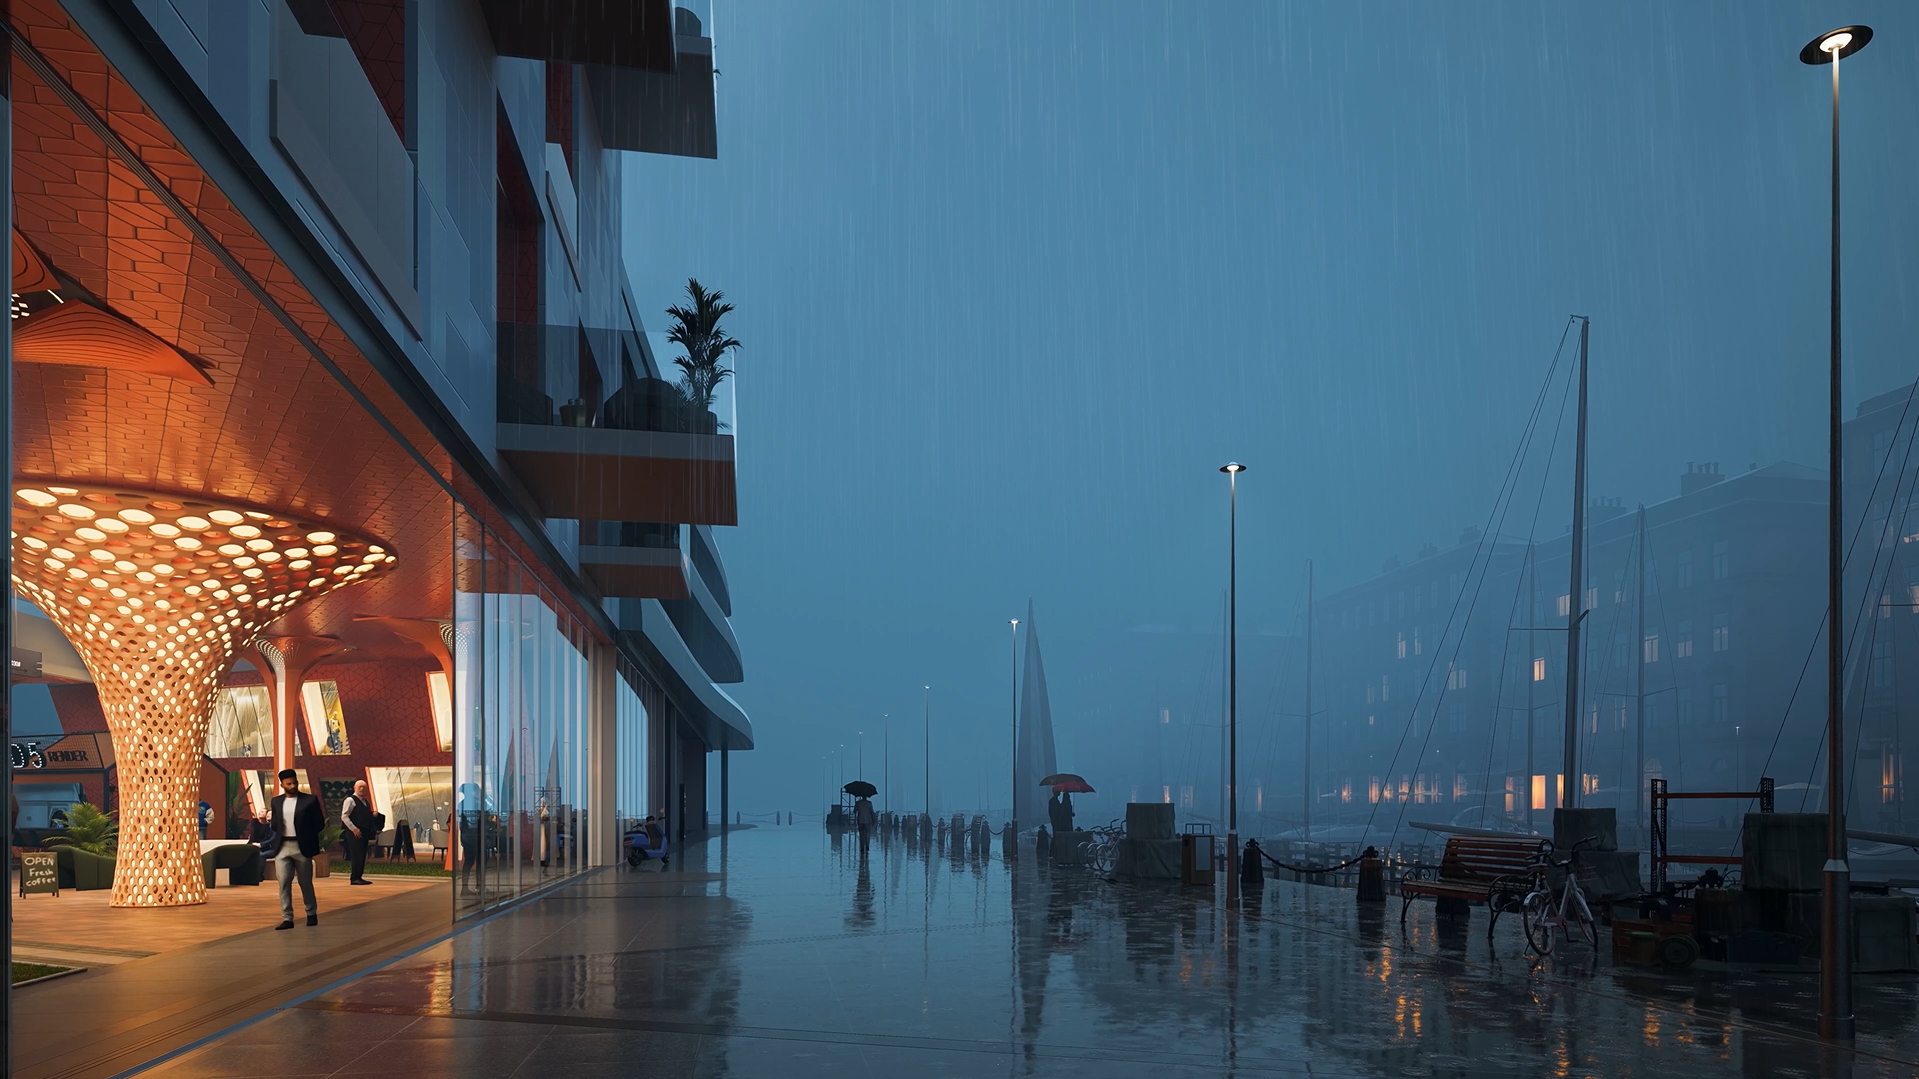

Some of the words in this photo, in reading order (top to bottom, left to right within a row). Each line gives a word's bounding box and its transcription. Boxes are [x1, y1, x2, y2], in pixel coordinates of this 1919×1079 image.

[47, 750, 89, 762] RENDER
[24, 857, 54, 866] OPEN
[29, 867, 54, 877] Fresh
[25, 877, 56, 887] coffee
